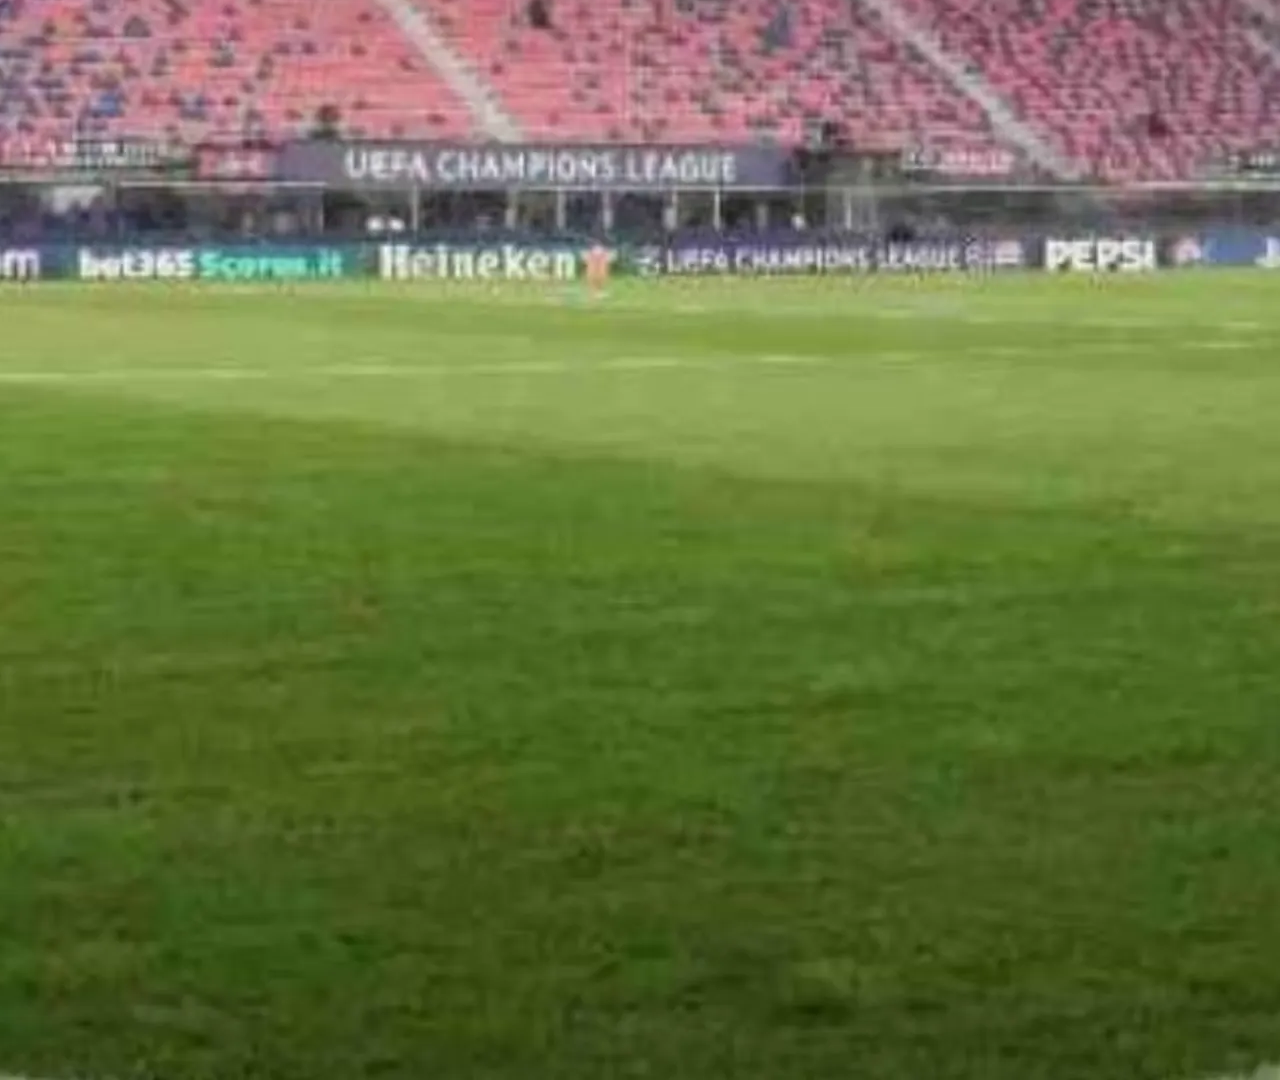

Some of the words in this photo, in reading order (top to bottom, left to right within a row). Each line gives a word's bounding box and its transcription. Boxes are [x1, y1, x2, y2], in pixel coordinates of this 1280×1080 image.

[344, 148, 431, 182] UEFA
[436, 149, 615, 183] CHAMPIONS
[624, 149, 738, 183] LEAGUE
[379, 242, 576, 281] Heineken
[1045, 237, 1158, 272] PEPSI
